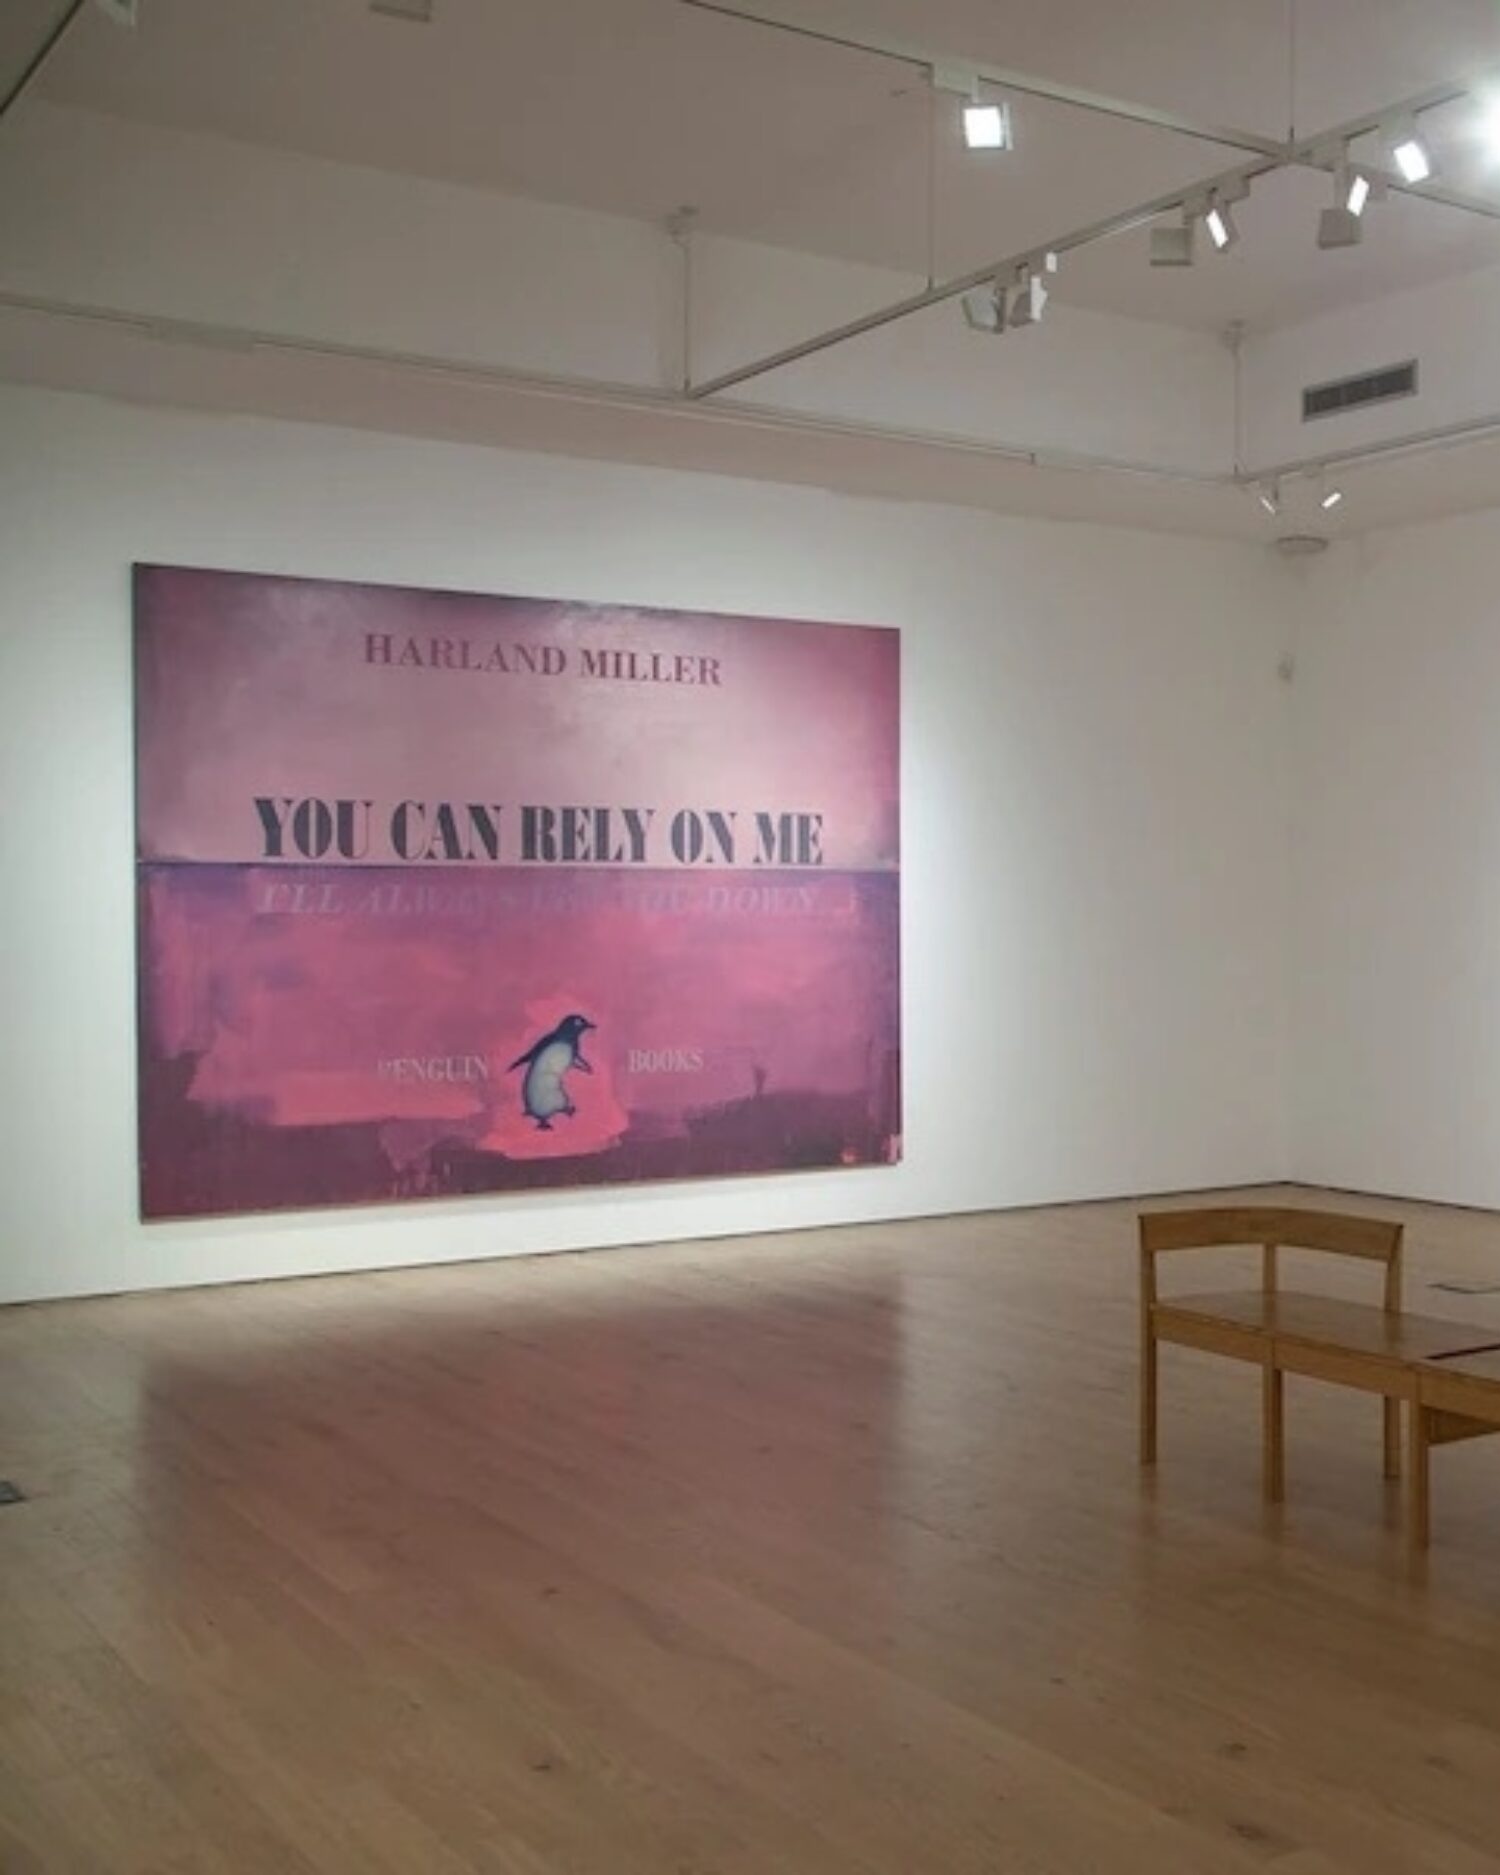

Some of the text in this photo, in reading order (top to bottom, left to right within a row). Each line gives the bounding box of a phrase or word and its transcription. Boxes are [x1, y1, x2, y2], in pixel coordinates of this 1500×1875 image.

[364, 633, 722, 686] HARLAND MILLER
[252, 796, 824, 866] YOU CAN RELY ON ME
[377, 1048, 705, 1083] PENGUIN BOOKS
